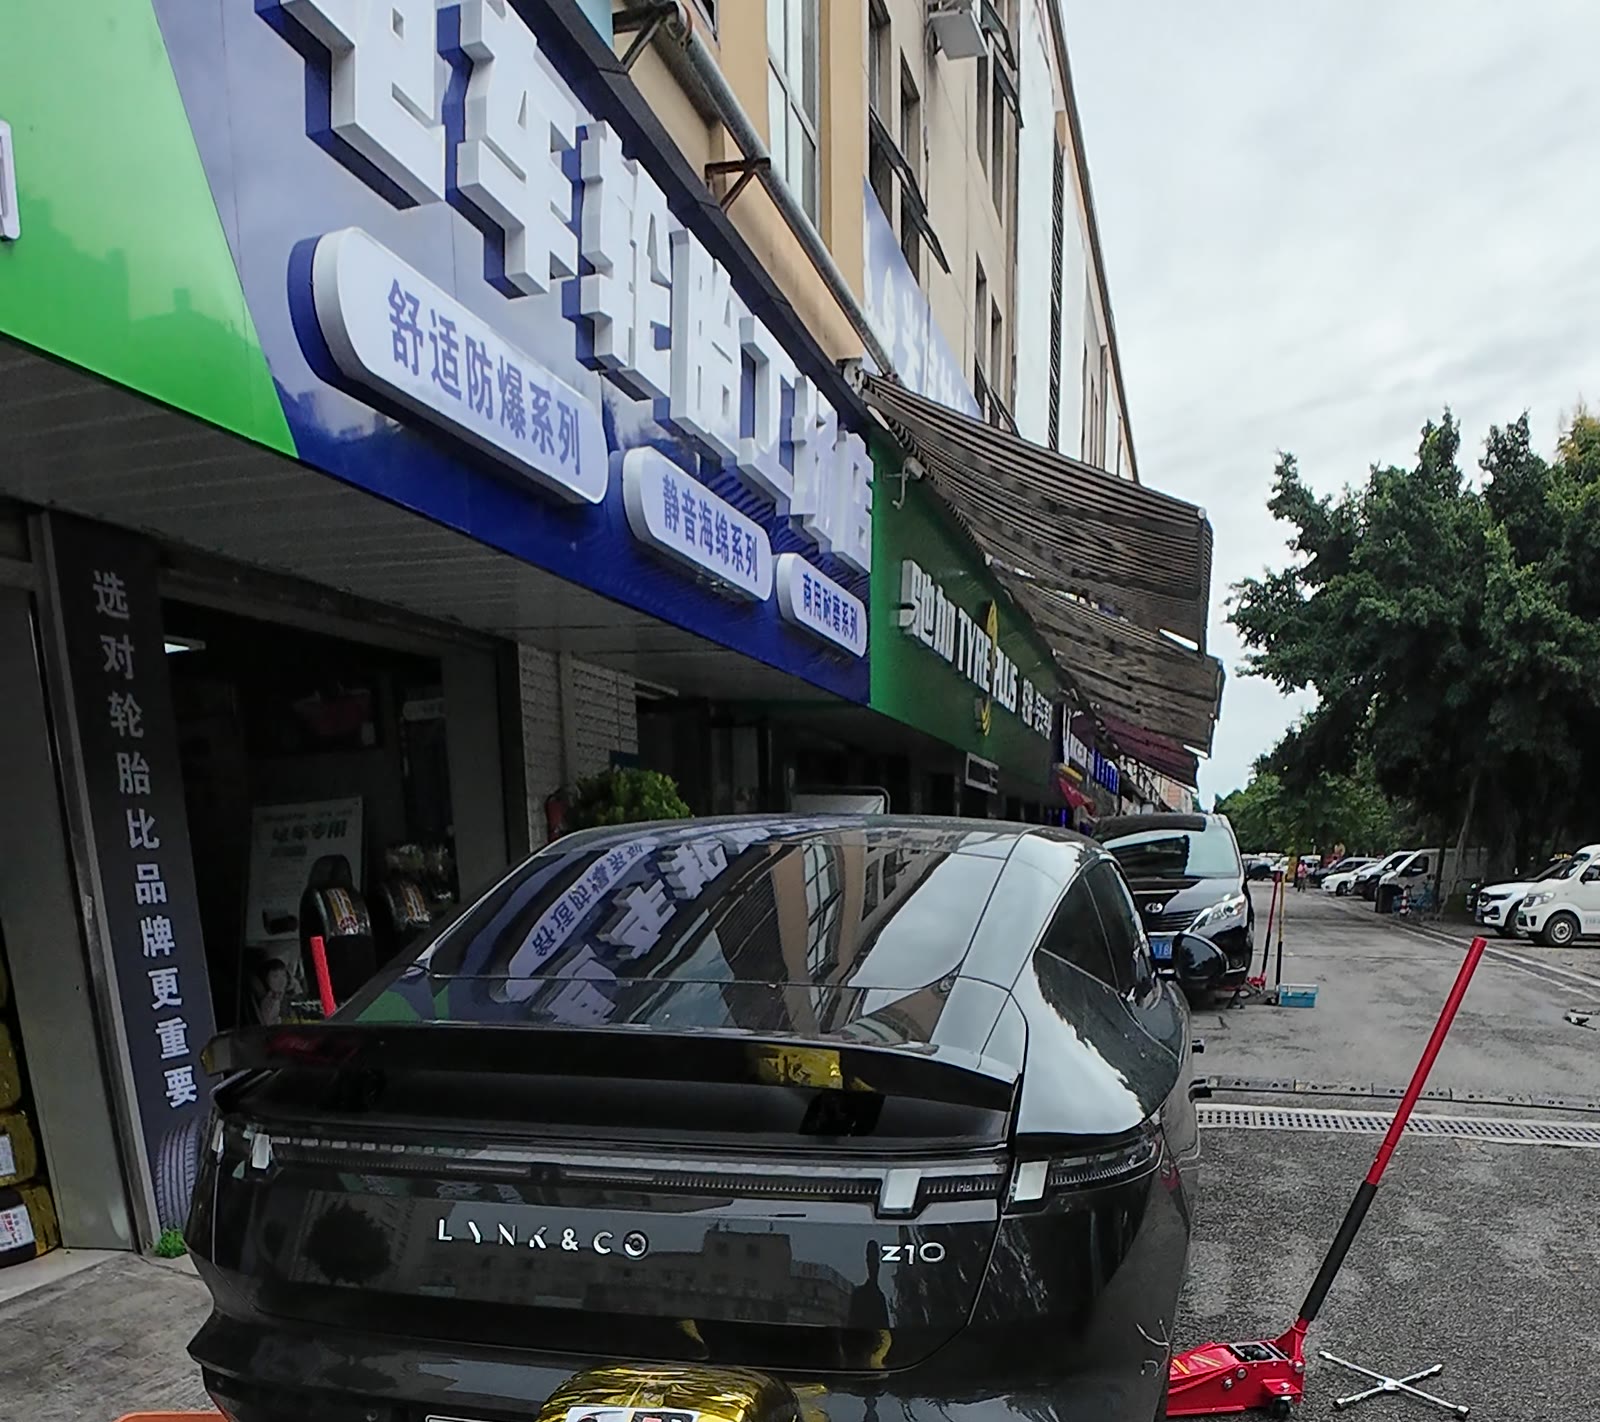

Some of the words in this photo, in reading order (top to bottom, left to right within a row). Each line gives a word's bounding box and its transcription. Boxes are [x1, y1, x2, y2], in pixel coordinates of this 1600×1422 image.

[388, 278, 581, 476] 舒适防爆系列
[662, 474, 758, 583] 静音海绵系列
[802, 572, 858, 644] 商用耐磨系列
[957, 607, 993, 693] TYRE
[93, 570, 198, 1108] 选对轮胎比品牌更重要
